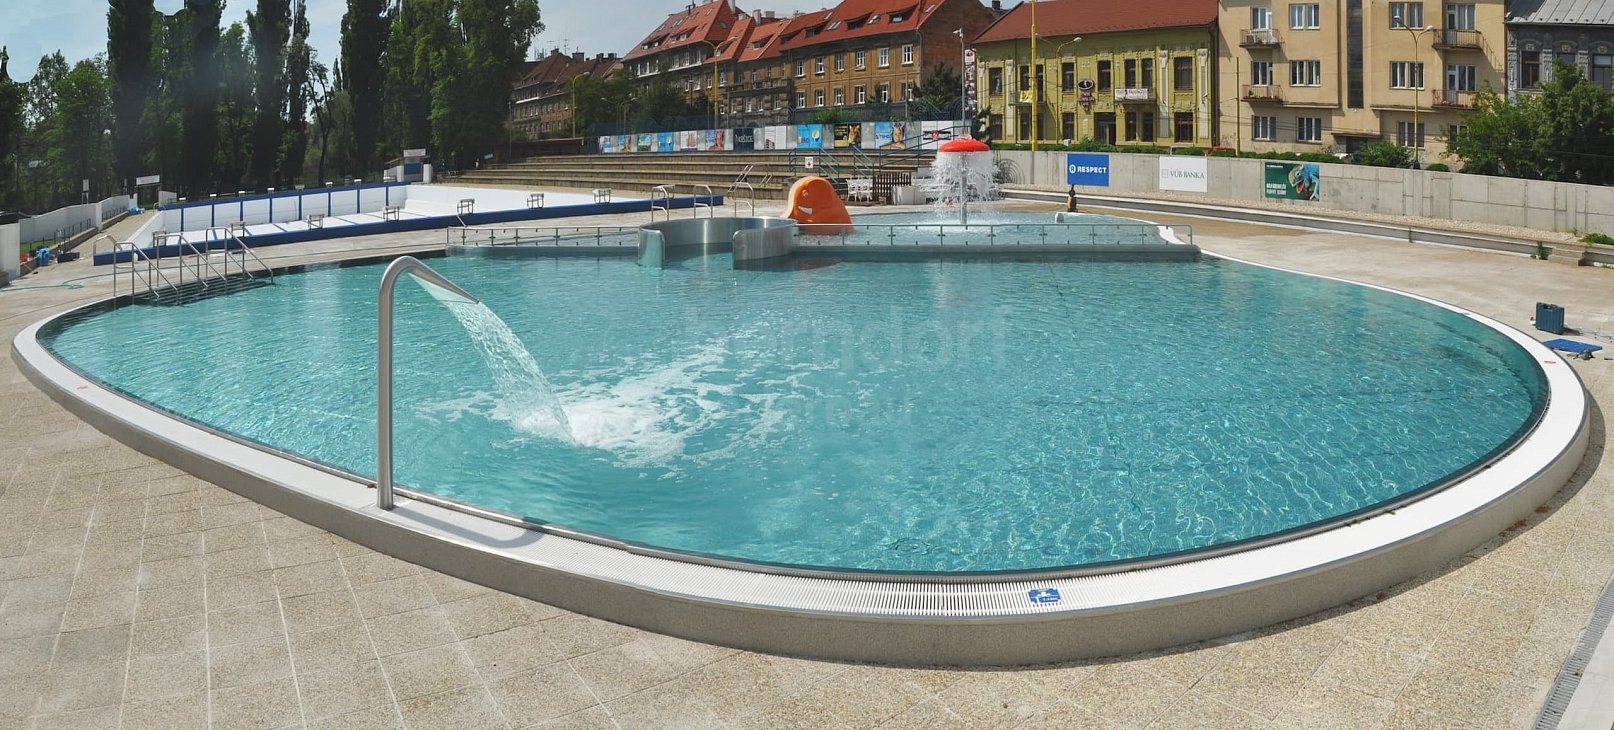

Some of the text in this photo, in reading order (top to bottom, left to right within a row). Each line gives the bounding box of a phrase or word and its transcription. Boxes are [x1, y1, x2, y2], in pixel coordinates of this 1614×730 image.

[1077, 165, 1107, 174] RESPECT
[1169, 168, 1205, 179] VÚB BANKA
